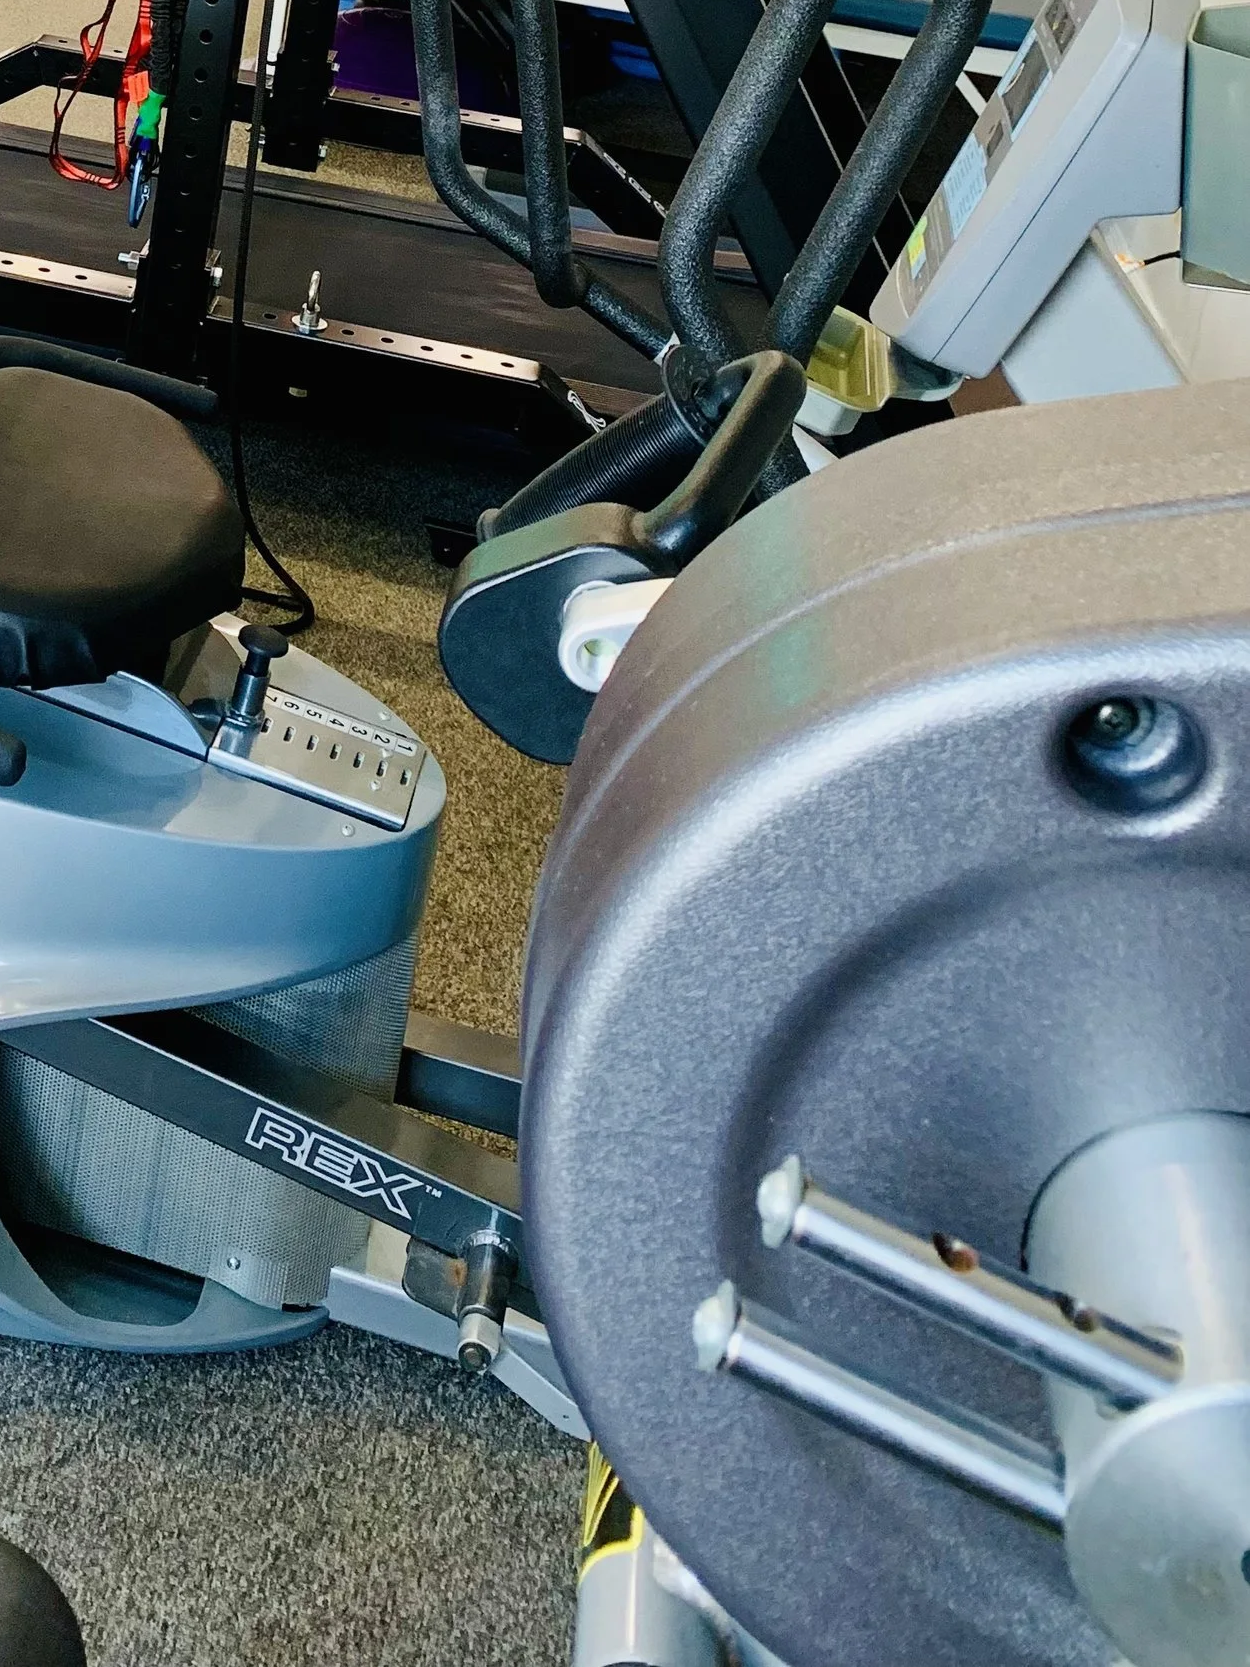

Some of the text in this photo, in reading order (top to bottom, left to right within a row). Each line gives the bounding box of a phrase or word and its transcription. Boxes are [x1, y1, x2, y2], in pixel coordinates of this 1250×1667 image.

[284, 701, 299, 712] 6
[306, 709, 322, 719] 5
[329, 718, 345, 728] 4
[351, 726, 368, 736] 3
[374, 734, 391, 745] 2
[397, 744, 413, 753] 1
[245, 1107, 424, 1220] REX
